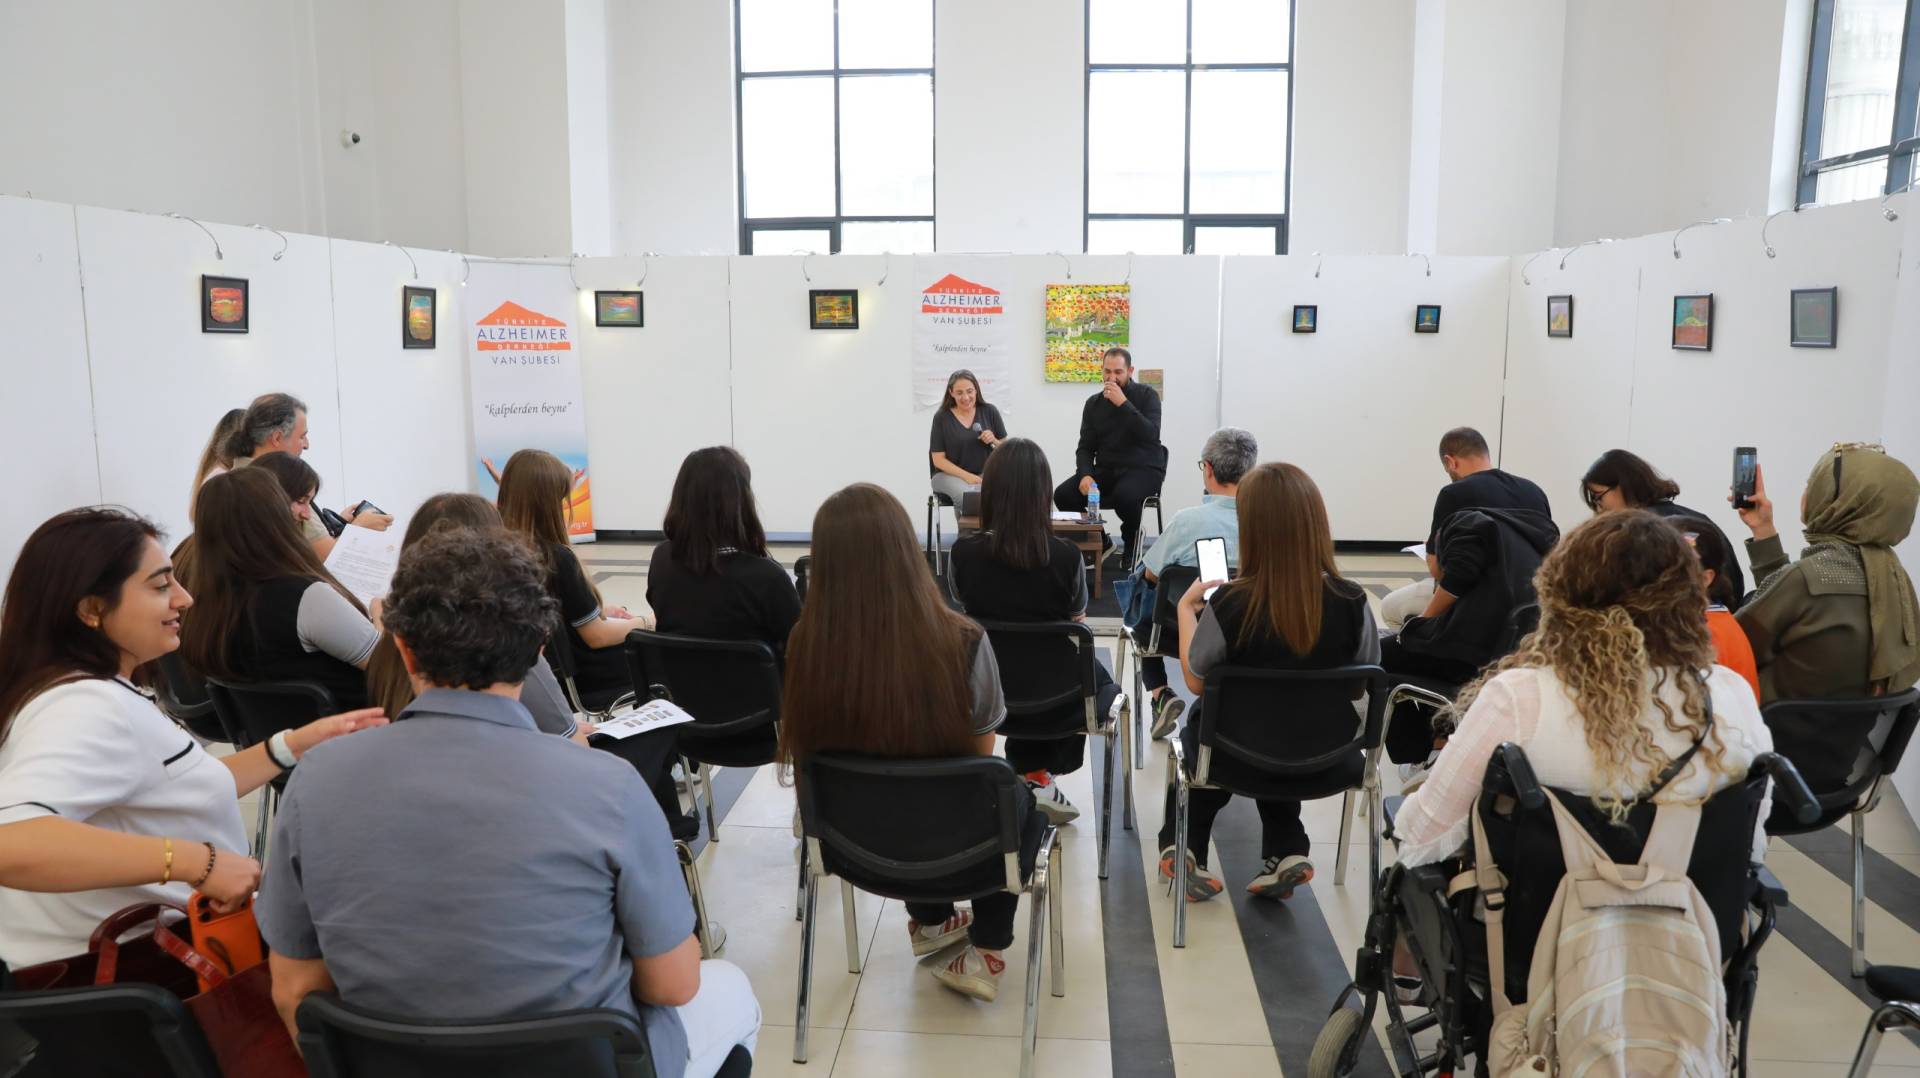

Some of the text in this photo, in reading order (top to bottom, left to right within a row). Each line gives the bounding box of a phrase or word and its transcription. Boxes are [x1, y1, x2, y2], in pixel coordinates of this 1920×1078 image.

[922, 295, 1000, 305] ALZHEIMER
[932, 316, 955, 325] VAN
[477, 328, 568, 340] ALZHEIMER
[491, 356, 517, 365] VAN
